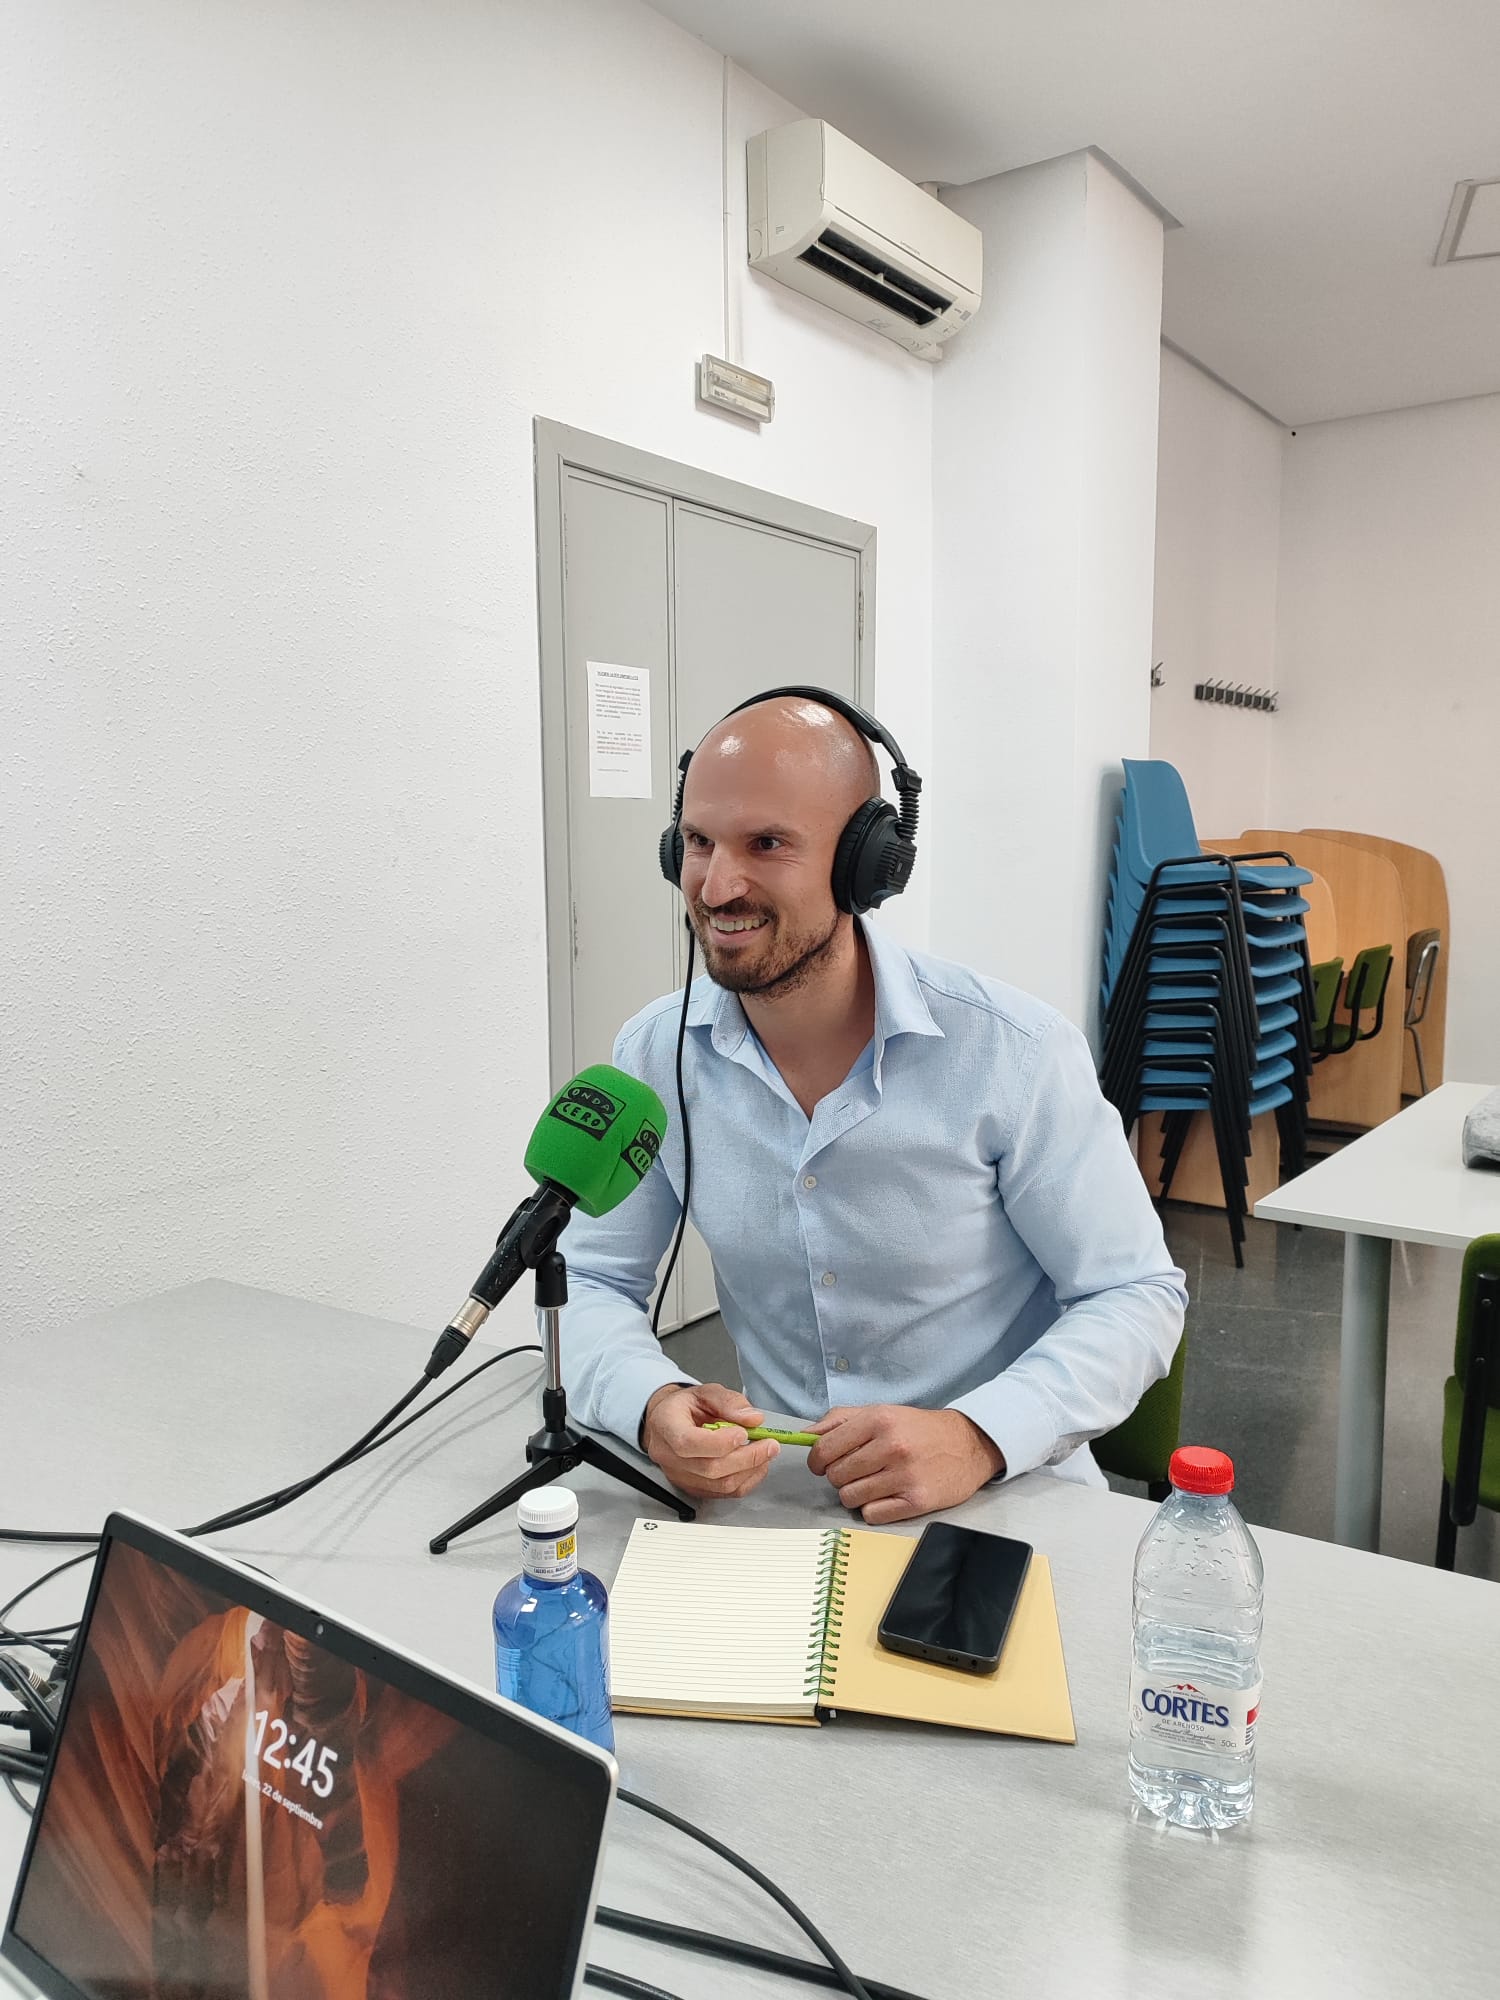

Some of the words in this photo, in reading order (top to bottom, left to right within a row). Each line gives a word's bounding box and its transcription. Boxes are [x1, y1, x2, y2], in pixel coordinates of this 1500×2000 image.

[571, 1088, 611, 1114] ONDA
[562, 1103, 601, 1127] CERO
[642, 1132, 659, 1153] OND
[1141, 1688, 1230, 1727] CORTES
[1161, 1718, 1171, 1726] DE
[1173, 1720, 1205, 1732] ARENOSO
[255, 1710, 338, 1798] 12:45
[262, 1782, 273, 1798] 22
[272, 1789, 282, 1803] de
[282, 1797, 324, 1831] septiembre
